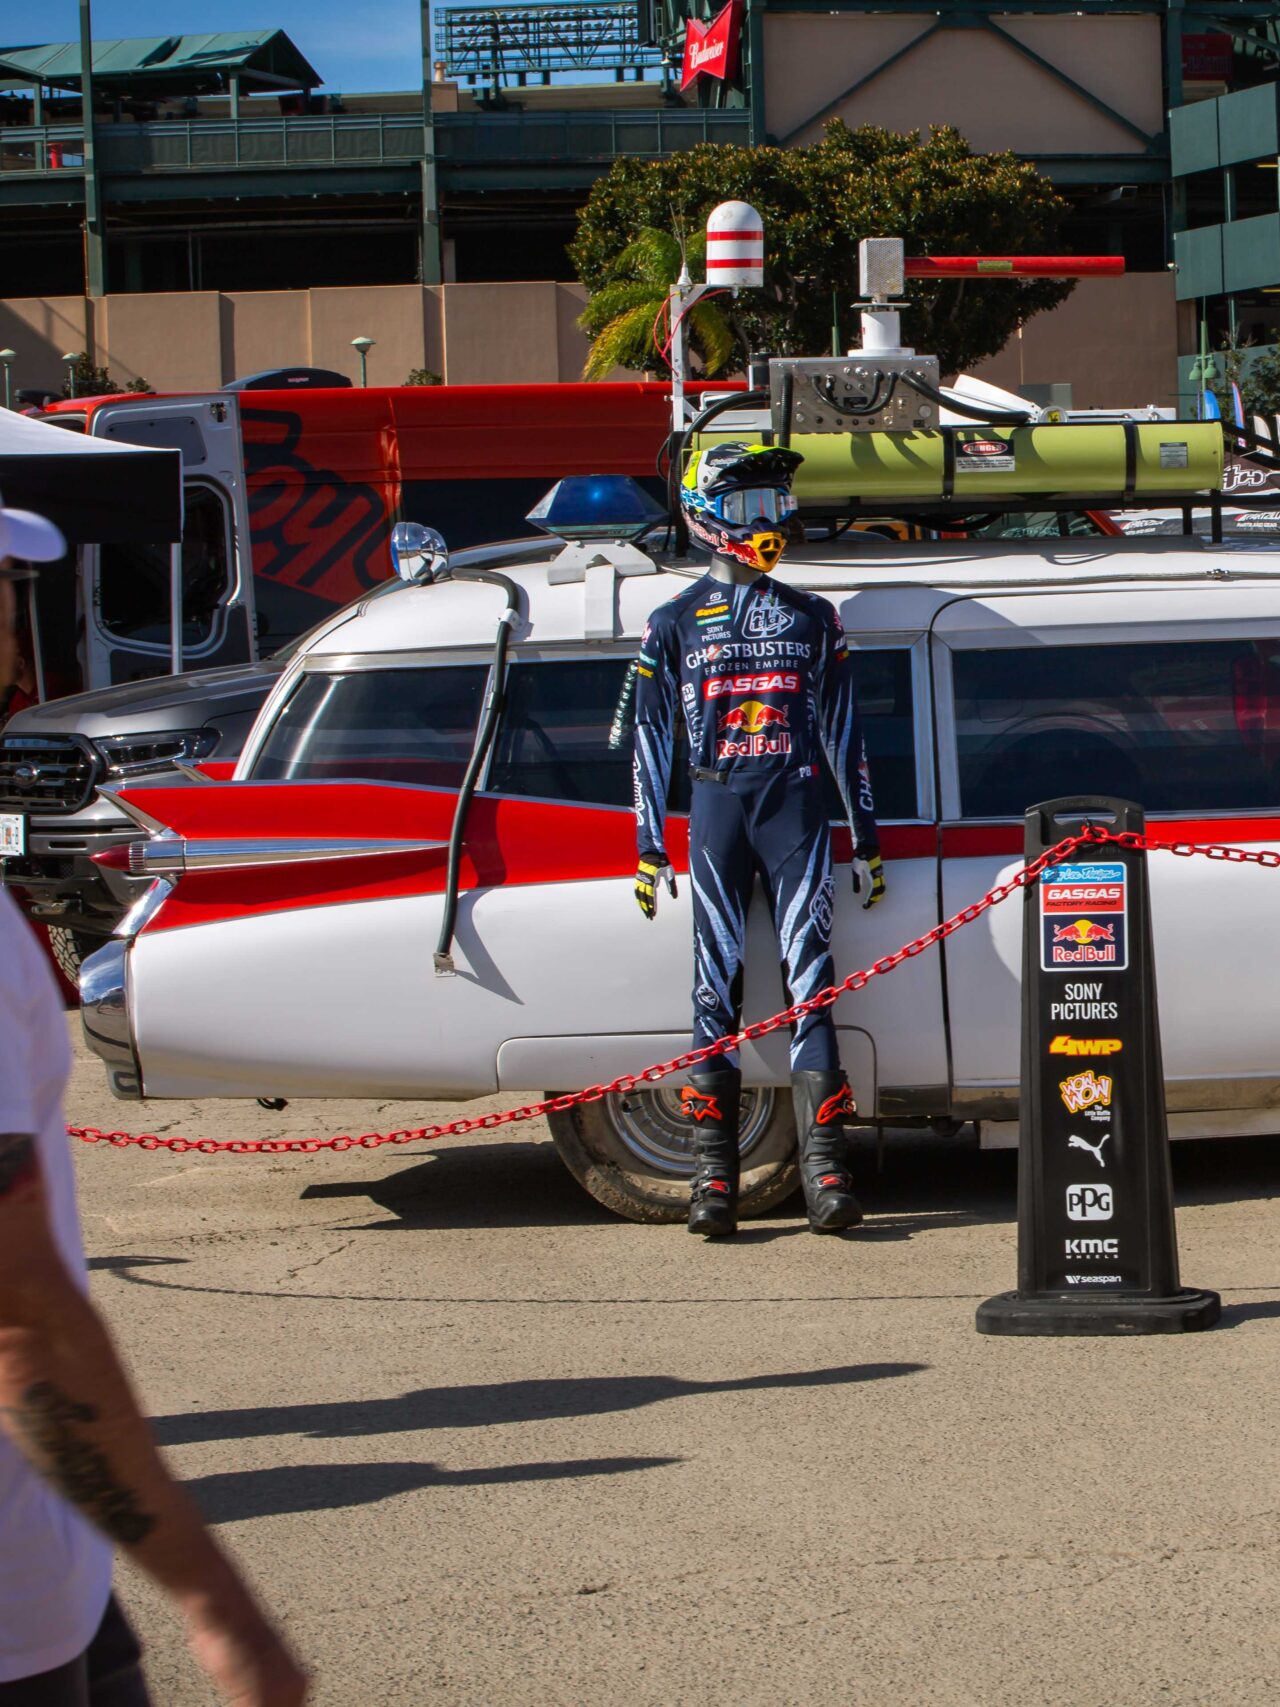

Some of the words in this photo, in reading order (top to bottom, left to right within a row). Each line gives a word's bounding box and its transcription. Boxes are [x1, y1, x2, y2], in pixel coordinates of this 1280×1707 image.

[701, 631, 732, 643] PICTURES
[706, 624, 724, 635] SONY
[704, 661, 750, 676] FROZEN
[755, 659, 800, 670] EMPIRE
[706, 674, 799, 698] GASGAS
[716, 735, 752, 760] Red
[753, 731, 792, 755] Bull
[1047, 888, 1121, 900] GASGAS
[1053, 945, 1084, 963] Red
[1085, 944, 1116, 961] Bull
[1064, 983, 1103, 1001] SONY
[1051, 1002, 1119, 1020] PICTURES
[1049, 1035, 1123, 1056] 4WP
[1068, 1187, 1111, 1218] PPG
[1081, 1275, 1122, 1284] seaspan
